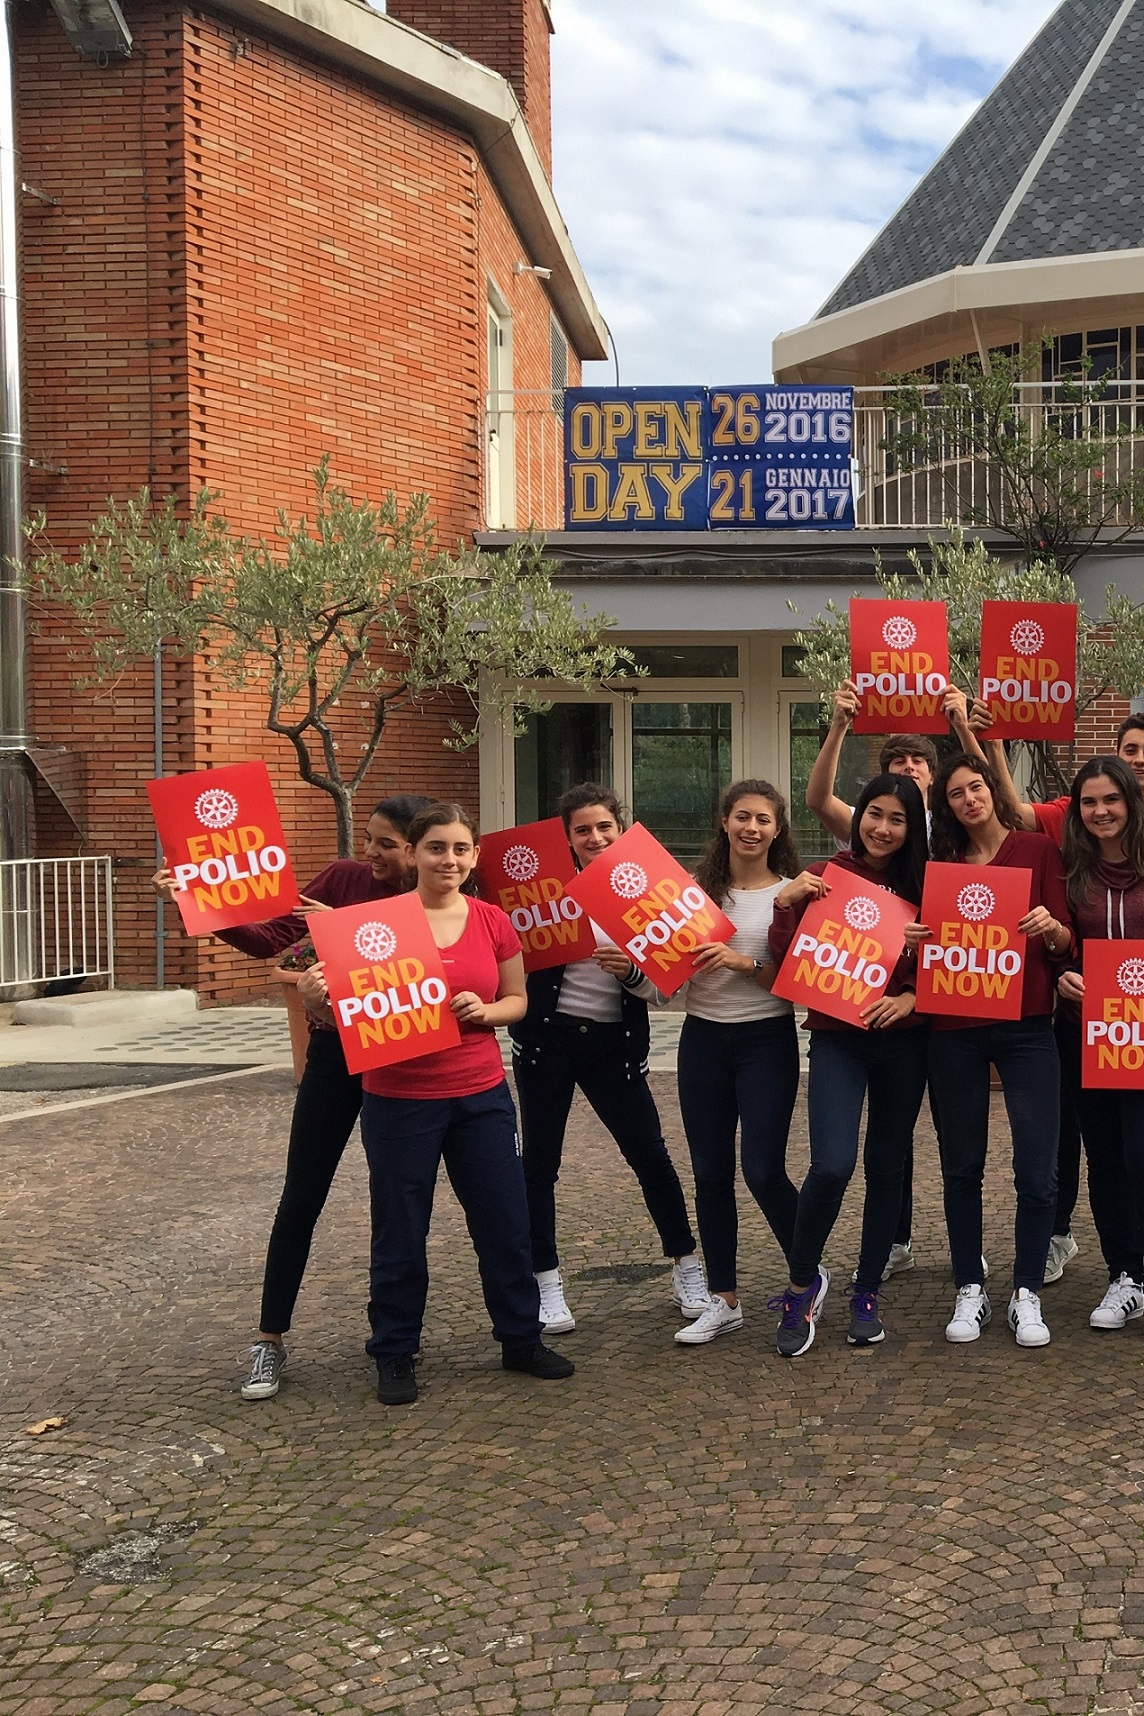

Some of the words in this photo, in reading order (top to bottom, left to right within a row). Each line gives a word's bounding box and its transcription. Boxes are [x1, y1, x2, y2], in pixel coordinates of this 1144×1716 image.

[712, 393, 760, 446] 26
[765, 393, 851, 410] NOVEMBRE
[571, 402, 702, 459] OPEN
[765, 412, 851, 443] 2016
[570, 463, 702, 522] DAY
[711, 469, 755, 521] 21
[765, 468, 850, 488] GENNAIO
[765, 489, 850, 521] 2017
[871, 652, 933, 674] END
[997, 656, 1059, 680] END
[856, 673, 946, 696] POLIO
[983, 678, 1072, 703] POLIO
[868, 695, 939, 716] NOW
[991, 701, 1063, 724] NOW
[187, 826, 265, 863] END
[174, 846, 286, 892] POLIO
[194, 871, 280, 912] NOW
[498, 878, 564, 912] END
[621, 878, 681, 934] END
[511, 896, 583, 932] OLIO
[626, 886, 706, 963] POLIO
[651, 907, 716, 972] NOW
[816, 918, 884, 962] END
[940, 922, 1009, 950] END
[348, 958, 425, 997] END
[792, 933, 887, 988] POLIO
[922, 944, 1022, 977] POLIO
[794, 959, 873, 1006] NOW
[932, 970, 1011, 999] NOW
[338, 978, 446, 1027] POLIO
[357, 1004, 440, 1049] NOW
